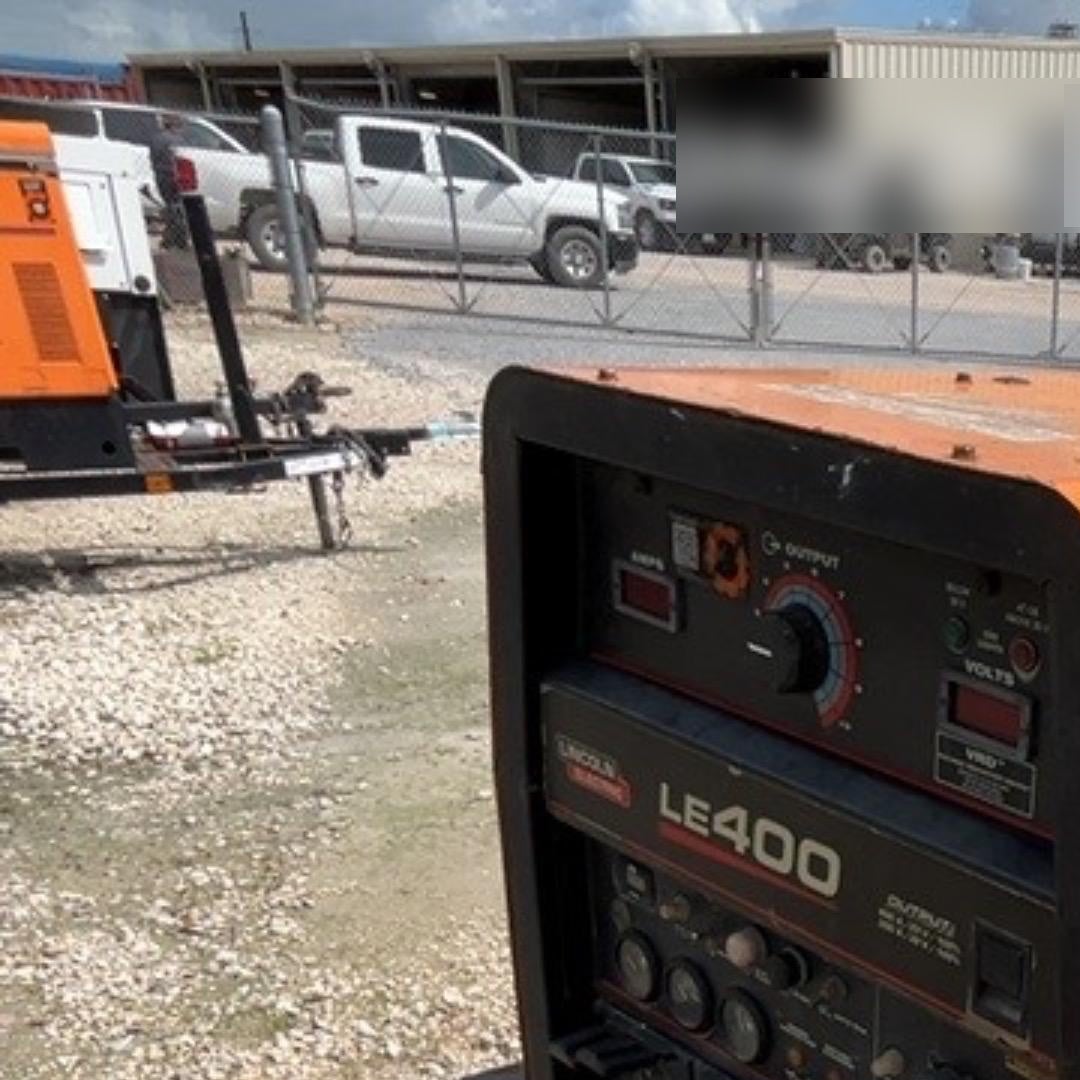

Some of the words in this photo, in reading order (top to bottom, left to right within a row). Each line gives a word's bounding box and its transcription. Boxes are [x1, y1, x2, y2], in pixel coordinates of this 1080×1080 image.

[785, 541, 841, 569] OUTPUT
[964, 658, 1016, 687] VOLTS
[659, 781, 841, 897] LE400
